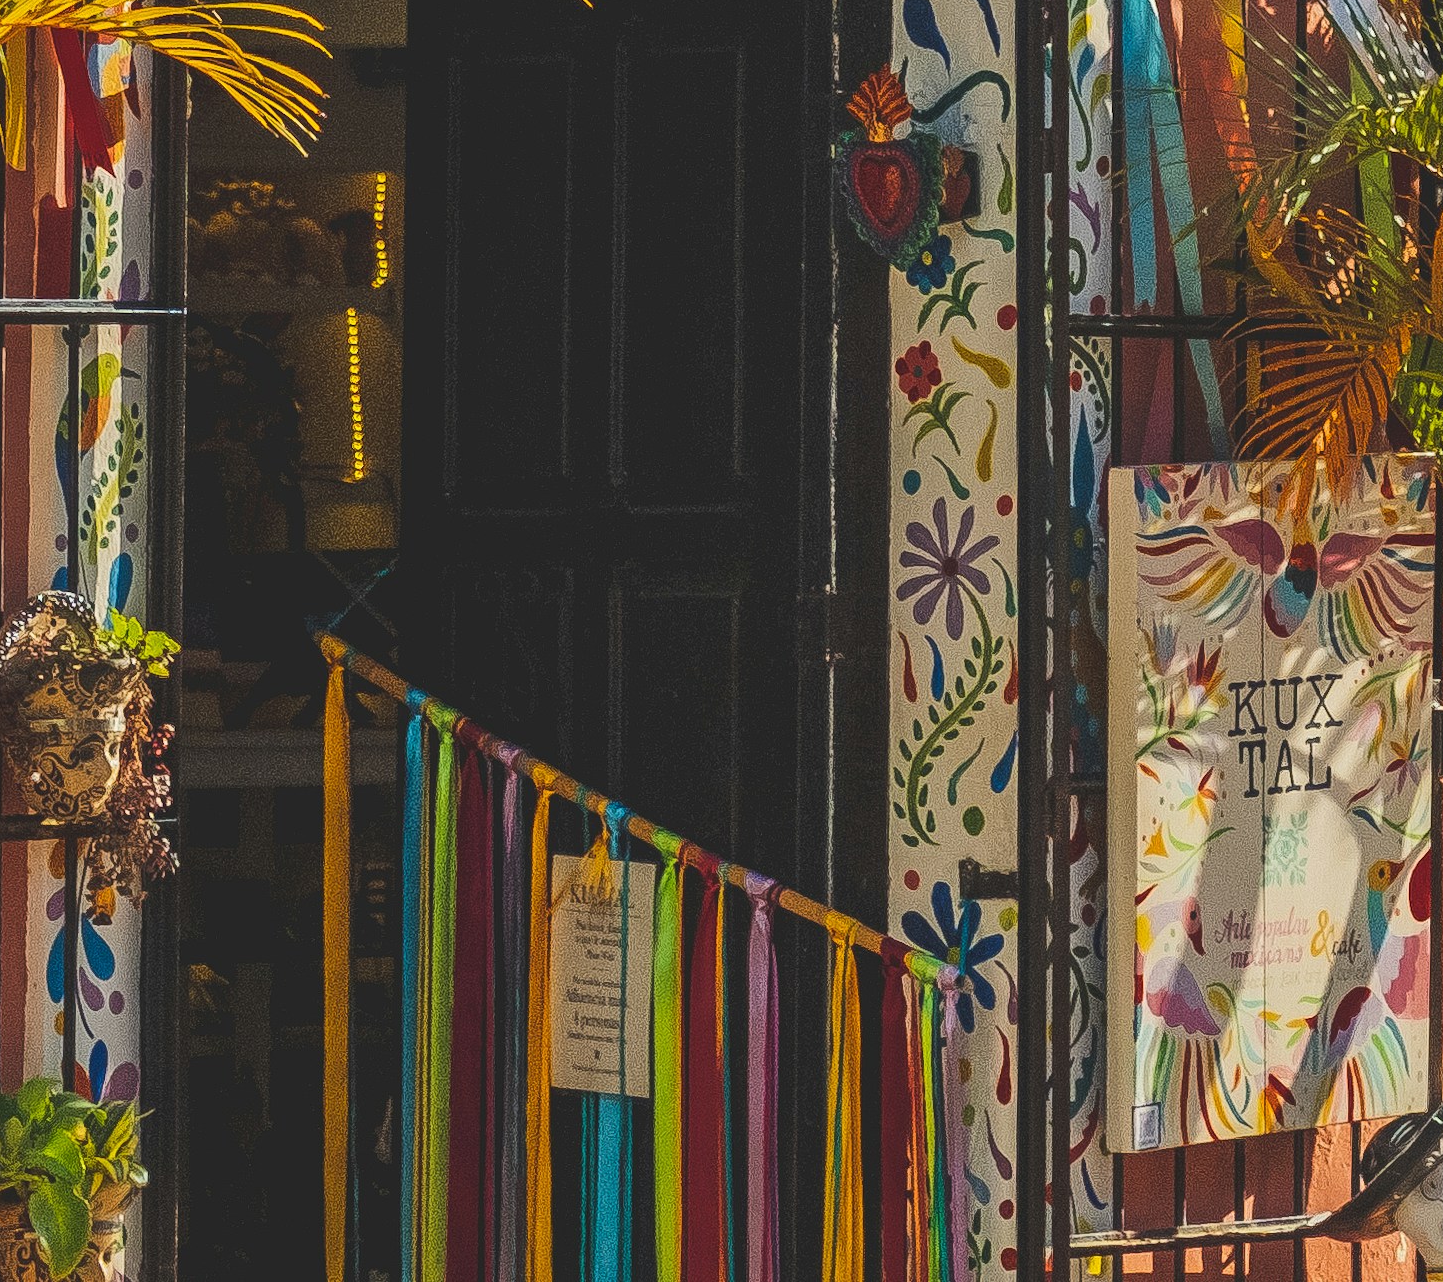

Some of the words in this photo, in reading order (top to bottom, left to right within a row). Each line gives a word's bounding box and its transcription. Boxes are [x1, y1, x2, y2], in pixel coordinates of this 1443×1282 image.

[1227, 674, 1345, 737] KUX
[1238, 736, 1333, 799] TAL
[1310, 909, 1335, 965] &
